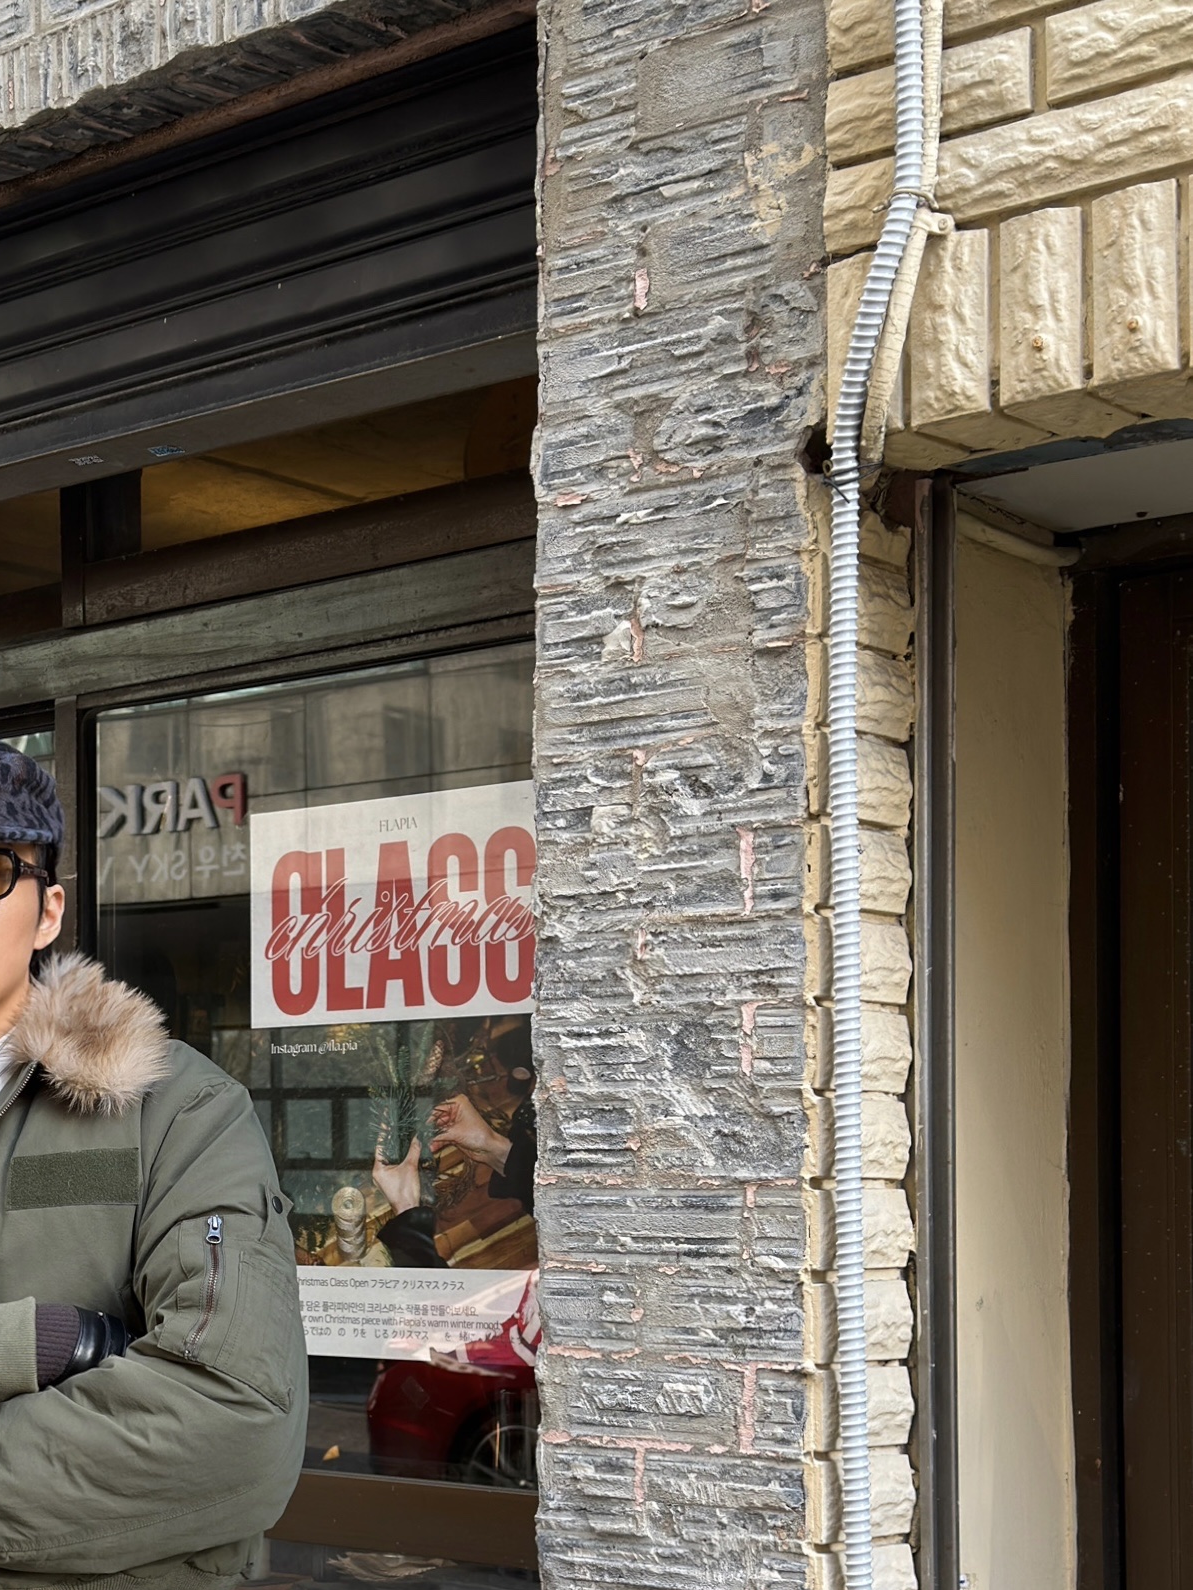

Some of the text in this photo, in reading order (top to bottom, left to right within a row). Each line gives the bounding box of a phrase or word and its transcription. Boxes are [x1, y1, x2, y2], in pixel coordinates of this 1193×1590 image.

[379, 816, 418, 833] FLAPIA
[271, 826, 537, 1016] CLASS
[271, 1043, 317, 1057] Instagram
[297, 1277, 329, 1287] hristmas
[330, 1278, 348, 1288] Class
[349, 1278, 369, 1290] Open
[367, 1303, 405, 1314] 크리스마스
[308, 1315, 324, 1323] own
[325, 1314, 360, 1325] Christmas
[361, 1316, 381, 1327] piece
[382, 1316, 398, 1326] with
[399, 1317, 426, 1330] Flapia's
[427, 1320, 449, 1328] warm
[450, 1319, 474, 1329] winter
